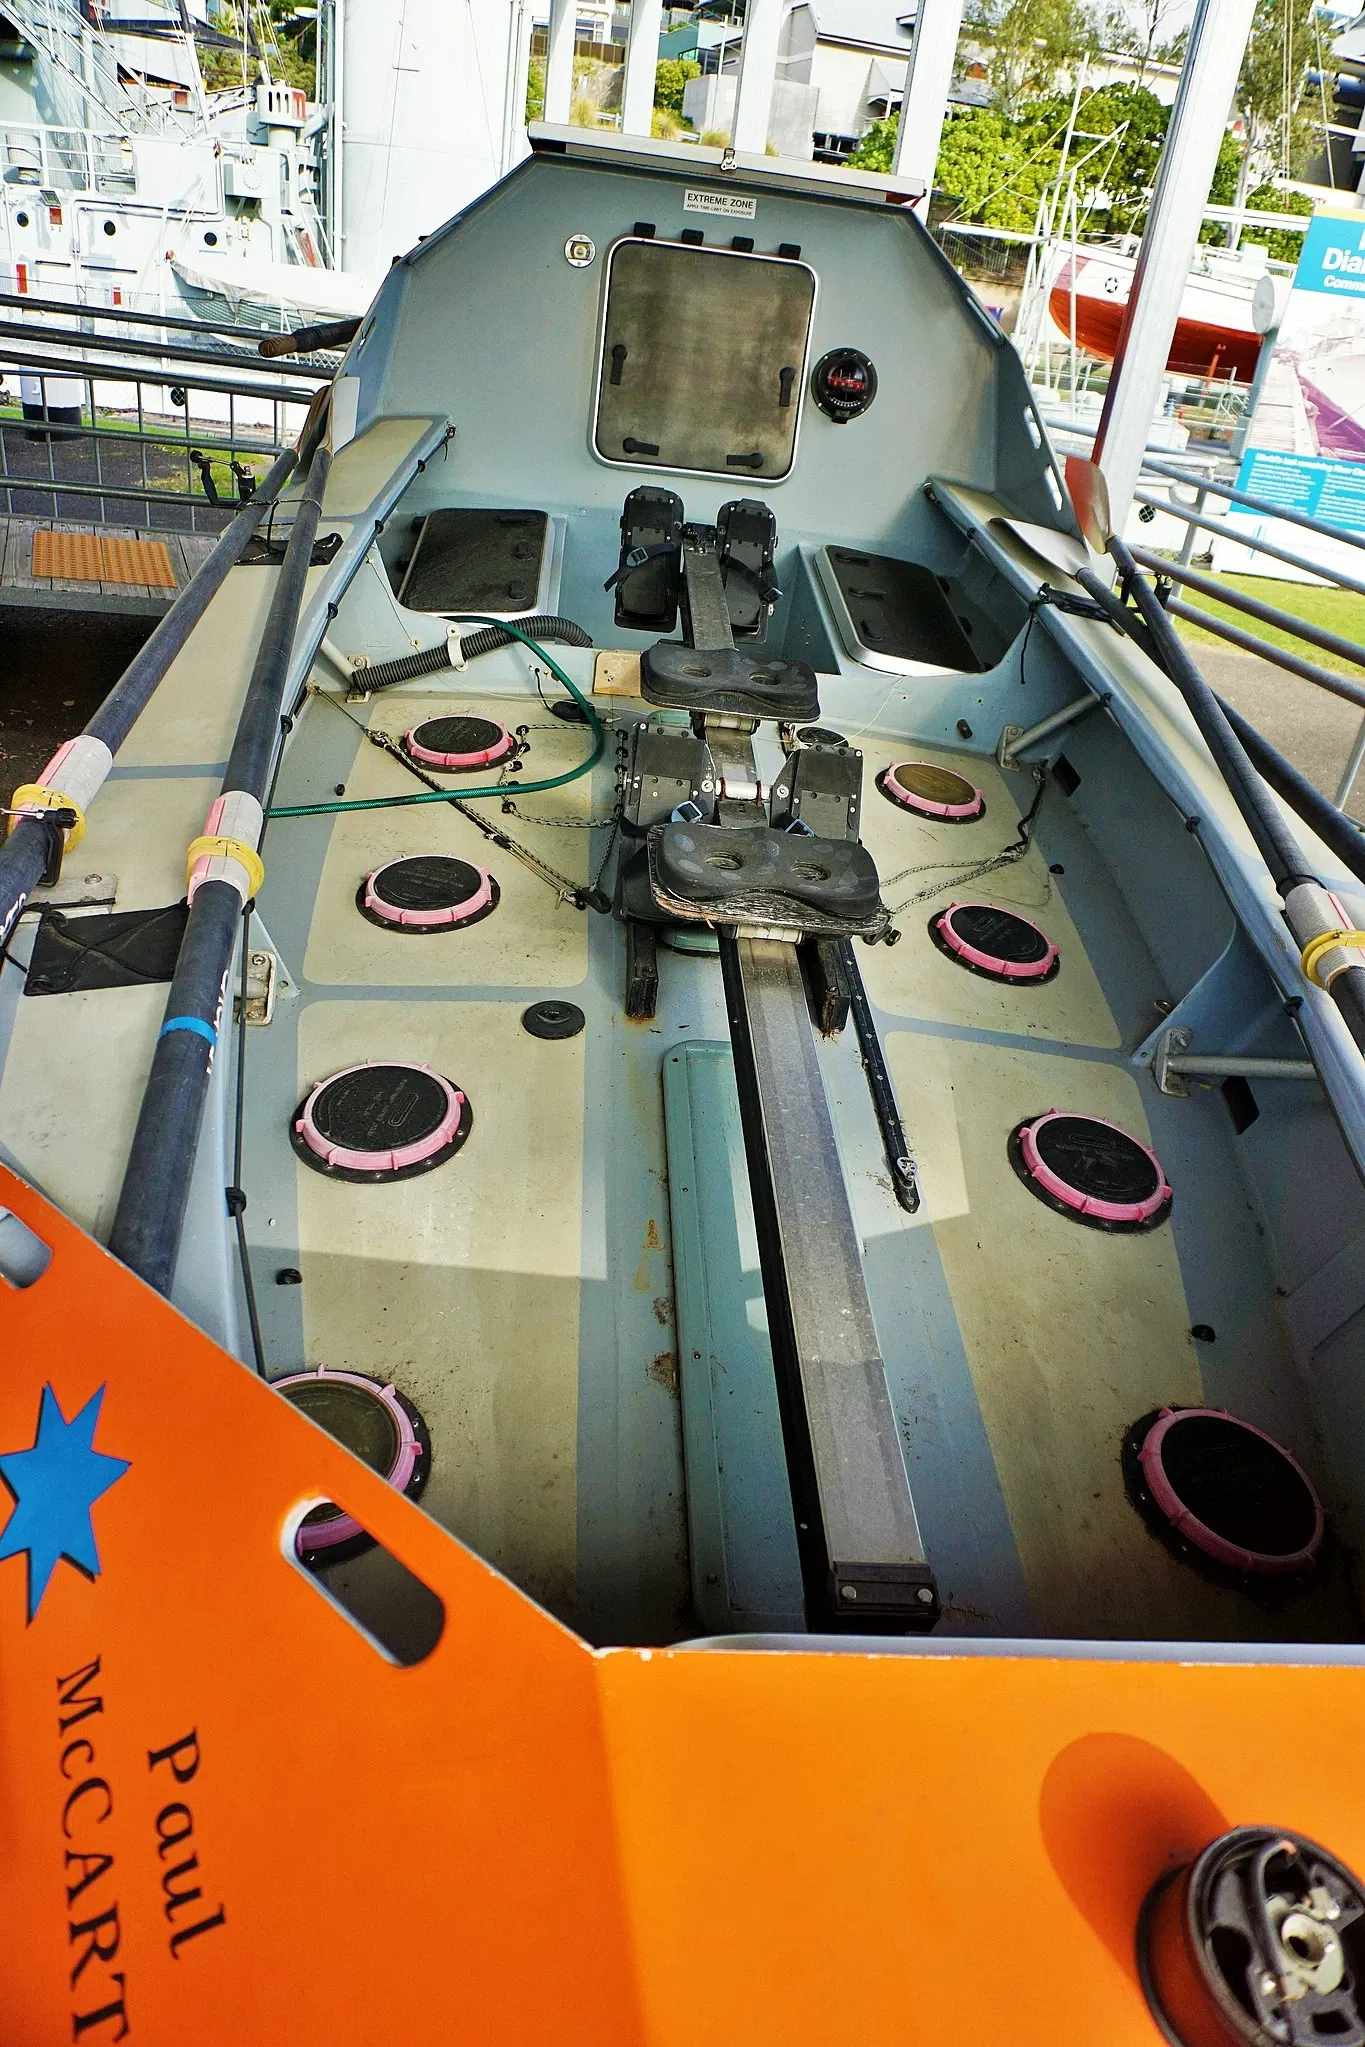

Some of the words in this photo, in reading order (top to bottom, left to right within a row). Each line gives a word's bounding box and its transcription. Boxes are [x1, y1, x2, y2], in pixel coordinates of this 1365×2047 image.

[687, 193, 728, 206] EXTREME
[730, 198, 754, 209] ZONE
[56, 1654, 131, 2044] McCART
[147, 1726, 227, 1962] Paul
